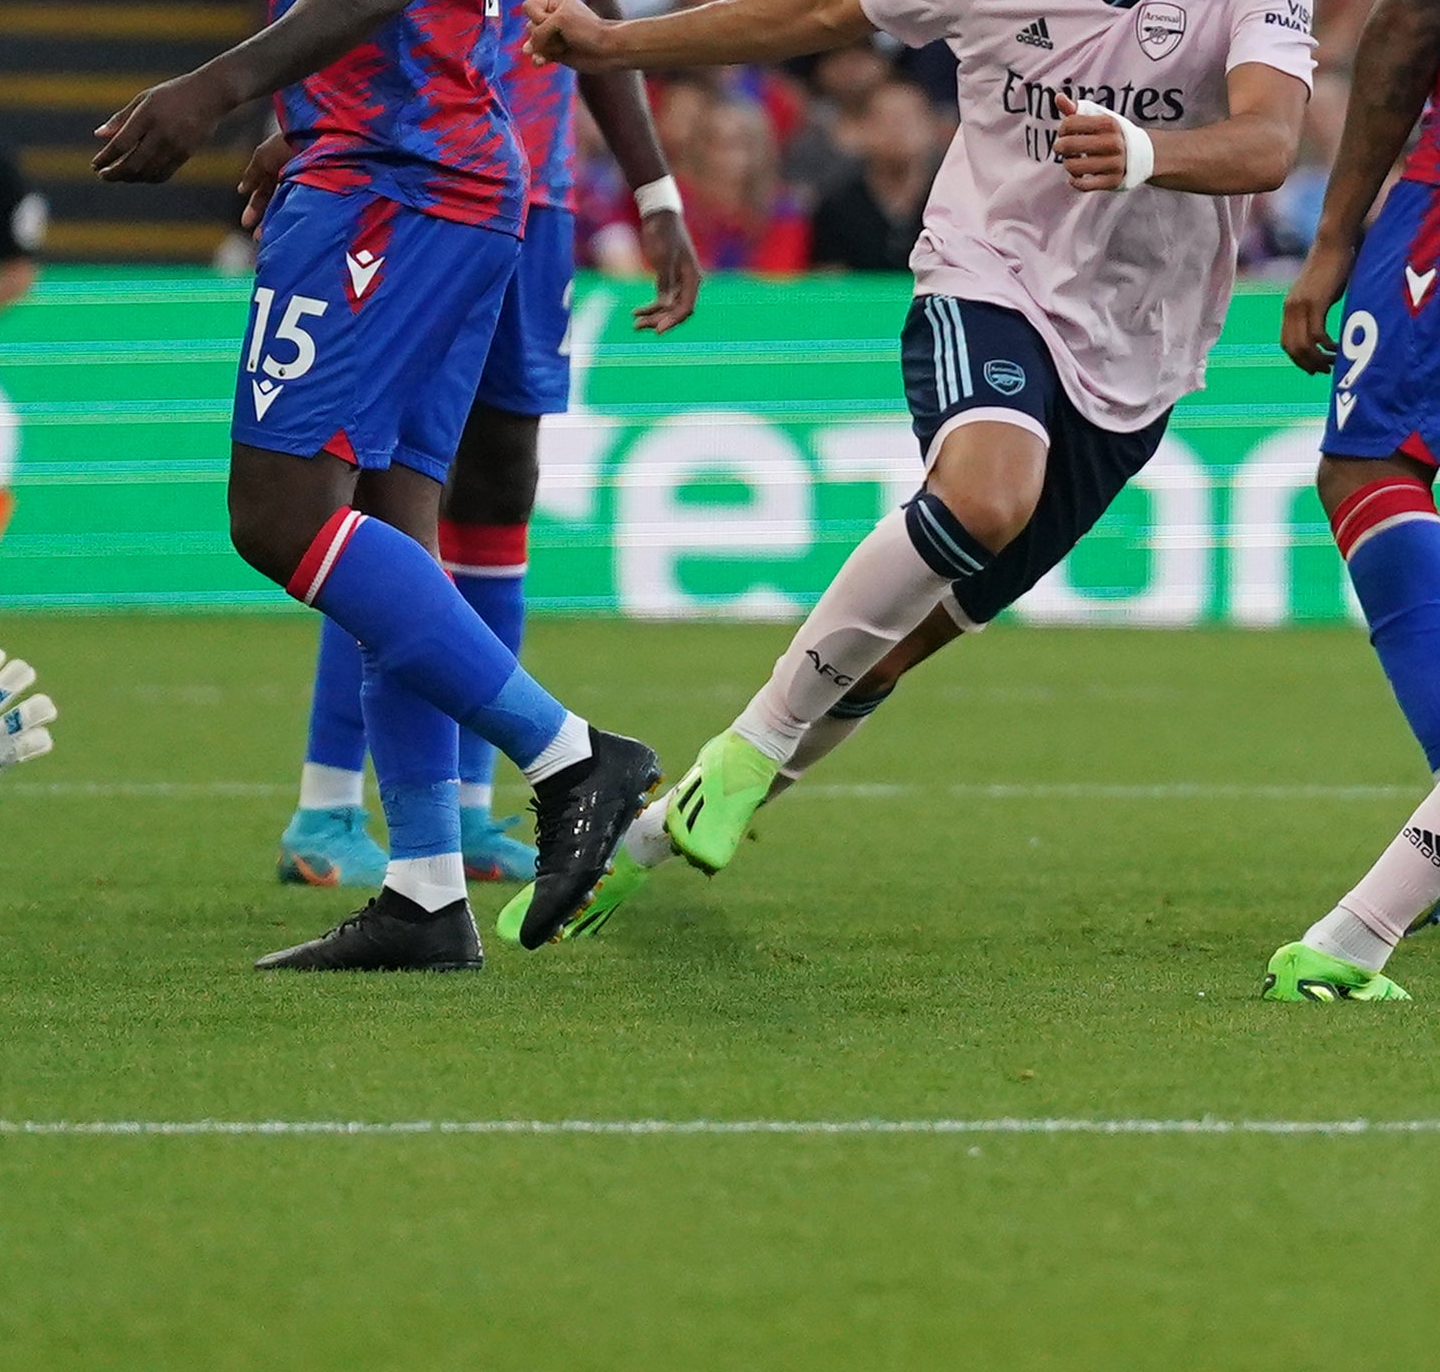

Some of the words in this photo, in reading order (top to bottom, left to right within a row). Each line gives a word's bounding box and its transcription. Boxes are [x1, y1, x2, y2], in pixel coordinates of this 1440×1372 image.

[1016, 33, 1054, 50] adidas
[1003, 68, 1185, 122] Emirates
[246, 286, 329, 380] 15
[1337, 309, 1379, 389] 9
[805, 649, 855, 687] AFC
